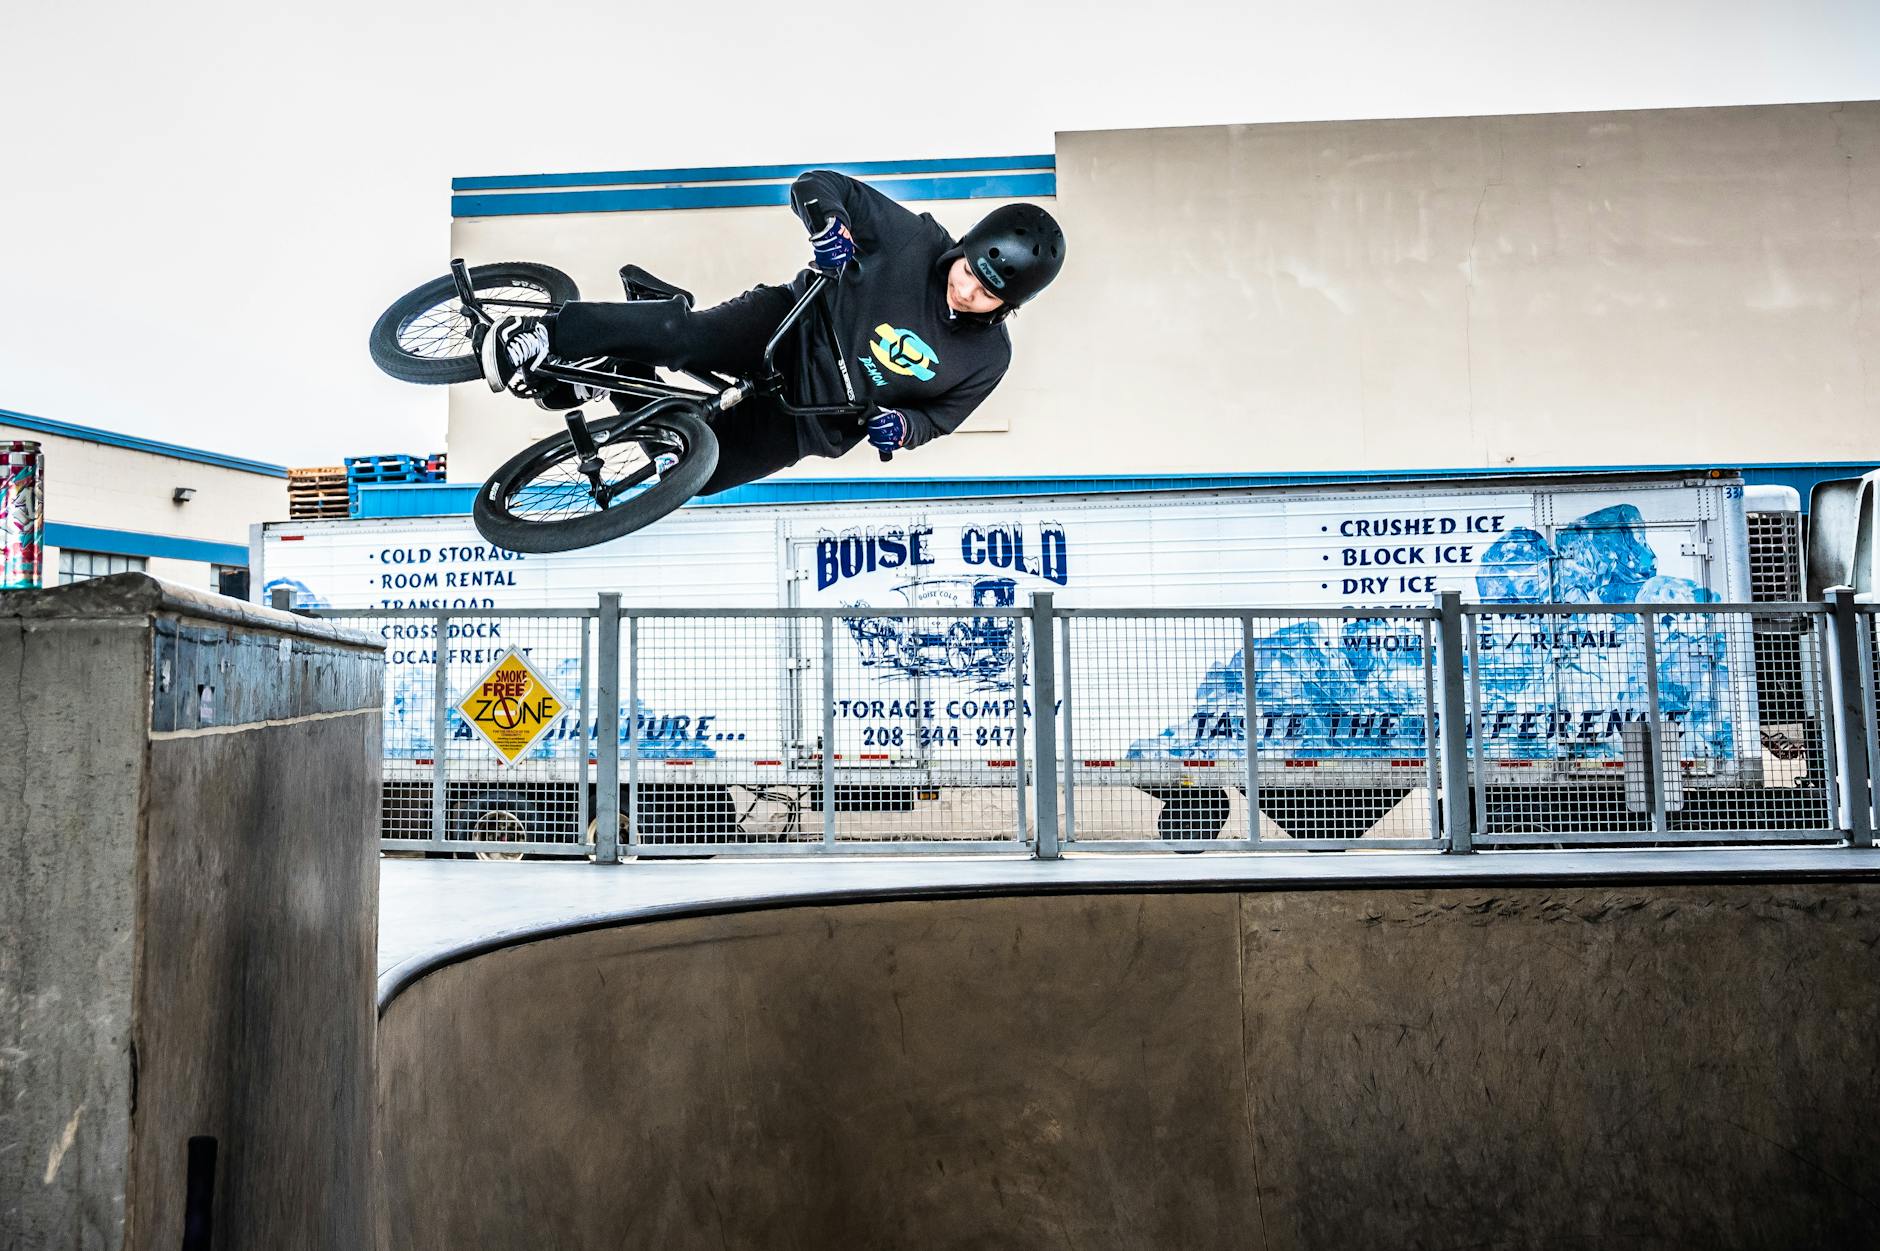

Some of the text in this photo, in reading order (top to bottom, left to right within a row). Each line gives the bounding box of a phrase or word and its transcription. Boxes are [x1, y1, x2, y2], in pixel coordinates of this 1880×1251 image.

[857, 355, 889, 387] DEMON
[1340, 515, 1505, 537] CRUSHED ICE
[381, 548, 431, 564] COLD
[816, 520, 1067, 591] BOISE COLD
[1342, 545, 1473, 566] BLOCK ICE
[381, 570, 517, 589] ROOM RENTAL
[1342, 575, 1437, 594] DRY ICE
[918, 590, 958, 600] BOISE COLD
[381, 623, 500, 640] CROSS DOCK
[1342, 633, 1493, 651] WHOLE
[1531, 630, 1621, 650] RETAIL
[447, 647, 533, 664] FREIGT
[496, 670, 527, 682] SMOKE
[483, 683, 525, 696] FREE
[474, 697, 553, 729] ZONE
[946, 699, 1063, 719] COMPAY
[1325, 711, 1402, 738] THE
[863, 725, 1027, 747] 208-344-847
